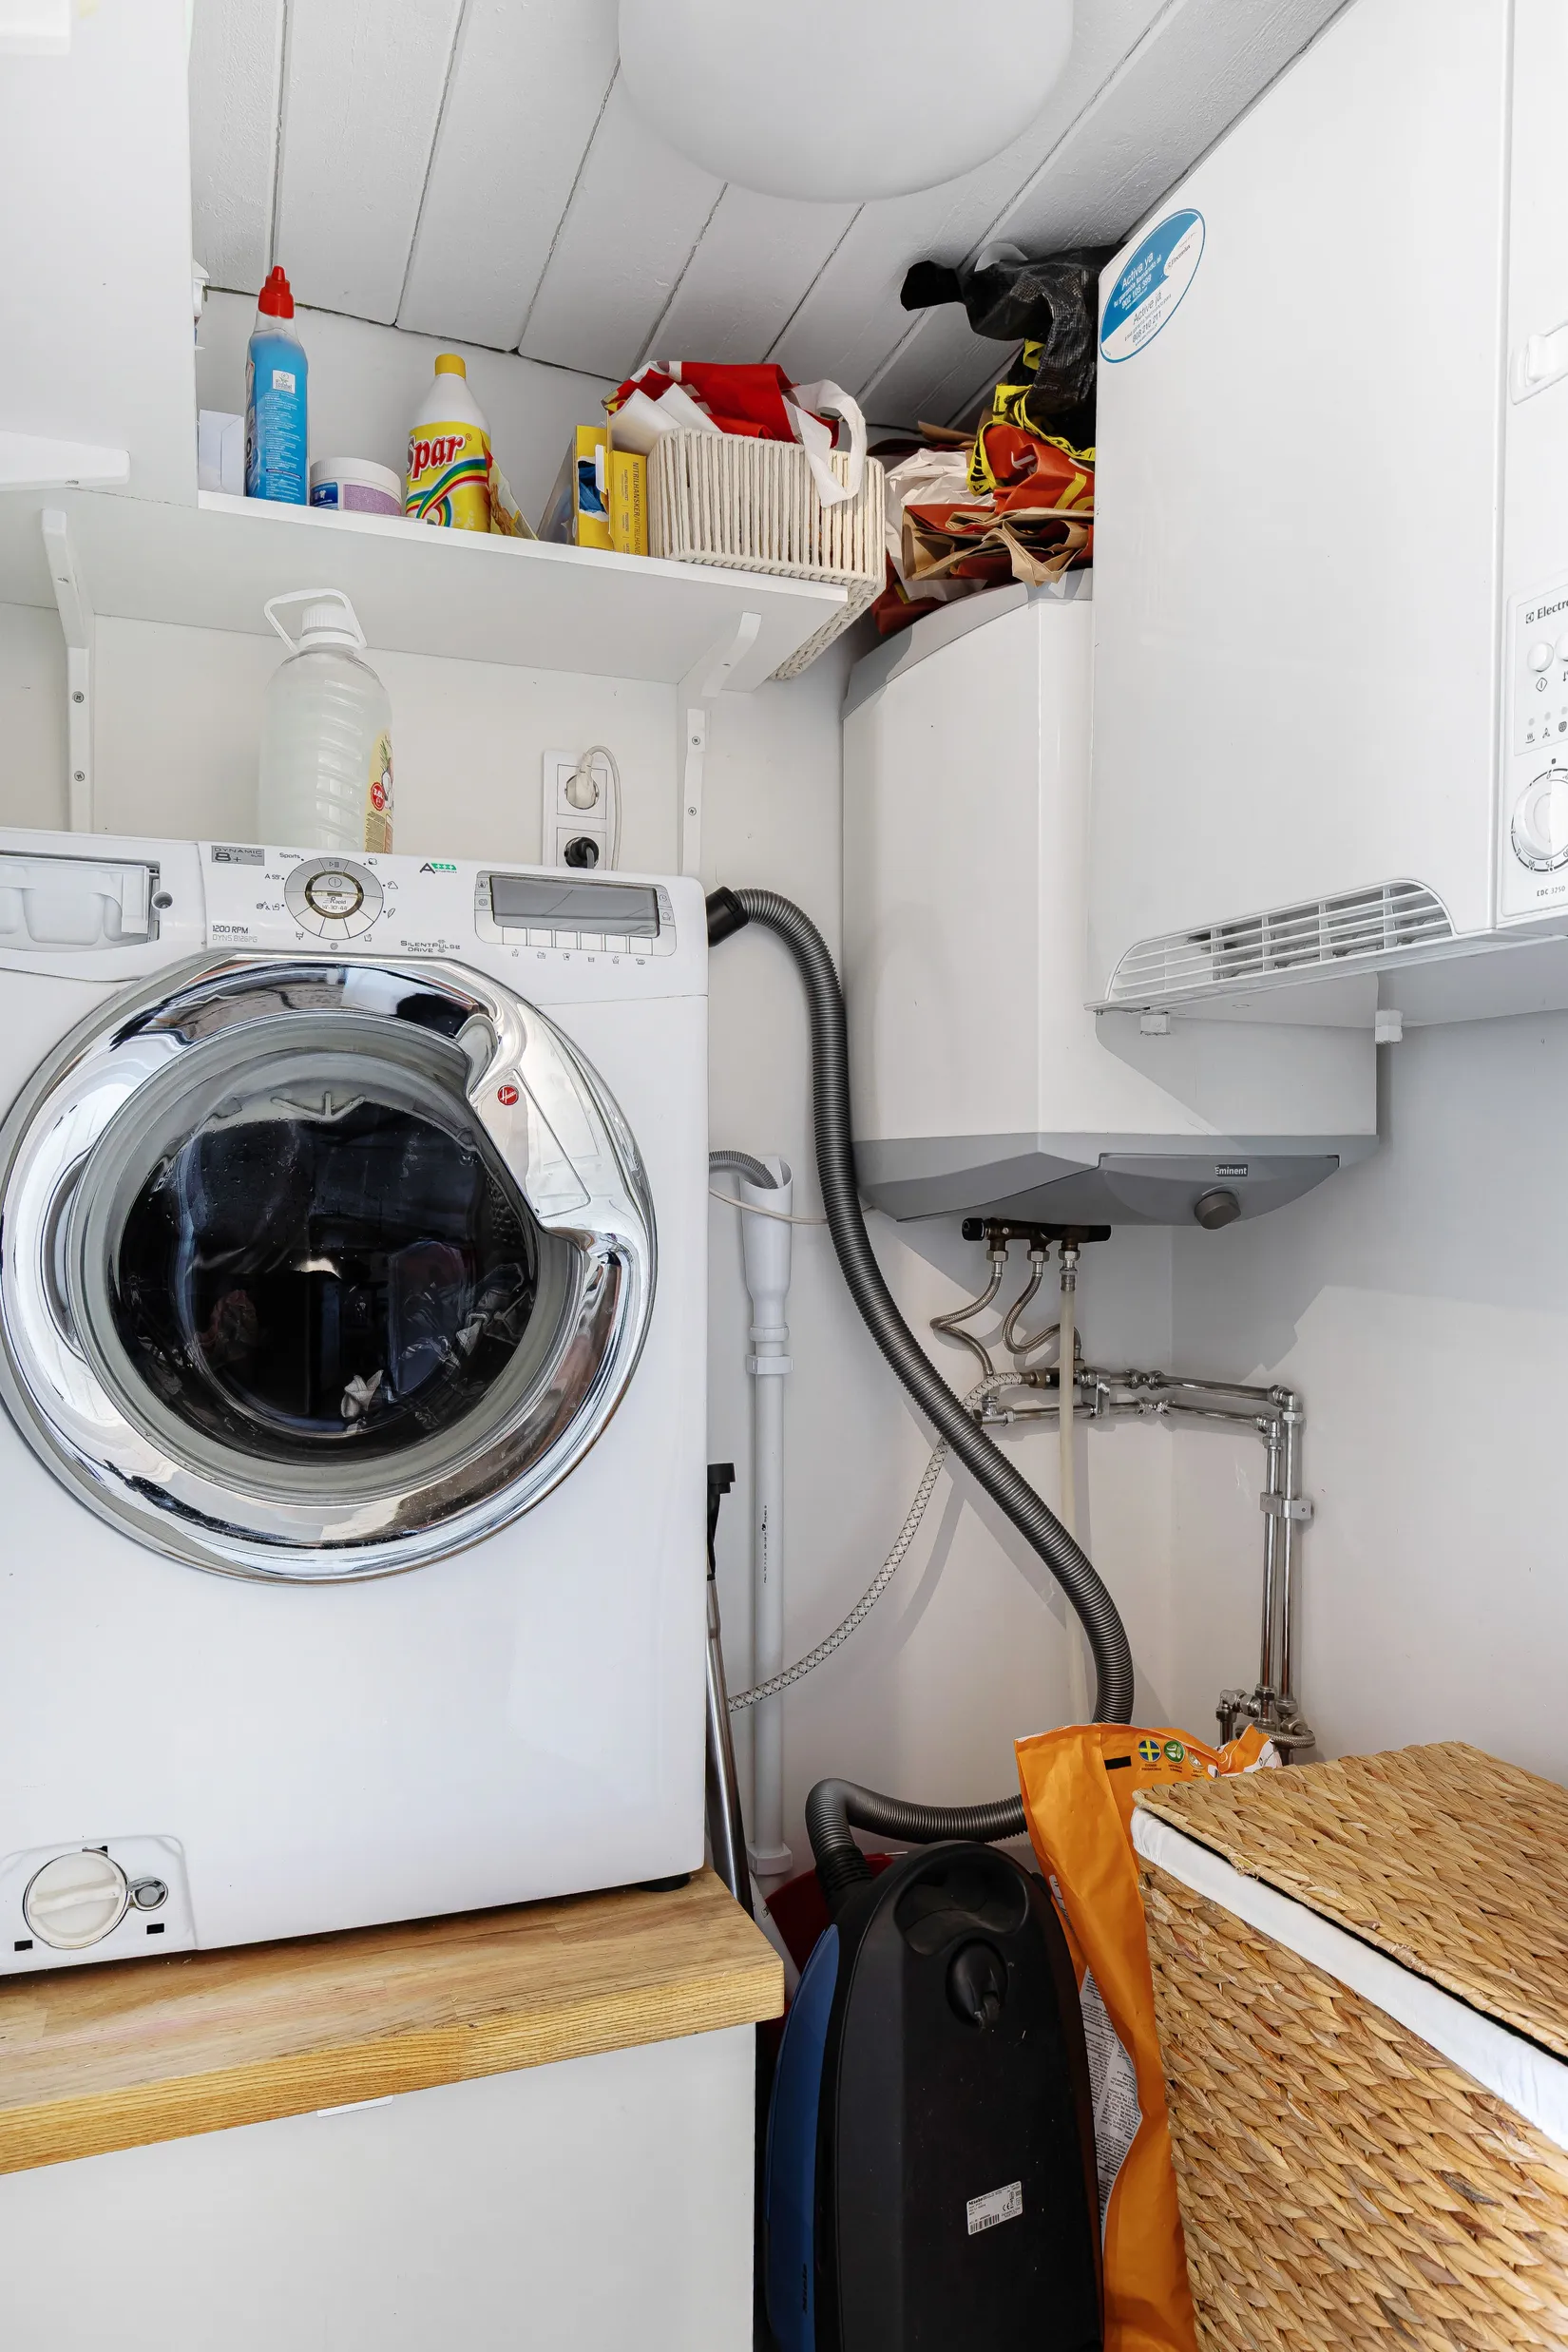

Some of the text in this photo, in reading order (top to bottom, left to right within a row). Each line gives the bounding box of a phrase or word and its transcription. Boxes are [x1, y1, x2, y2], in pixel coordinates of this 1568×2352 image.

[1121, 251, 1155, 292] Activa ya
[1132, 298, 1155, 326] Active
[214, 847, 262, 855] DYNAMIC
[278, 851, 301, 860] Sports
[1537, 885, 1566, 897] EDC 3250
[329, 896, 347, 906] Rapid
[212, 925, 249, 934] 1200 RPM
[1214, 1166, 1248, 1176] Eminent
